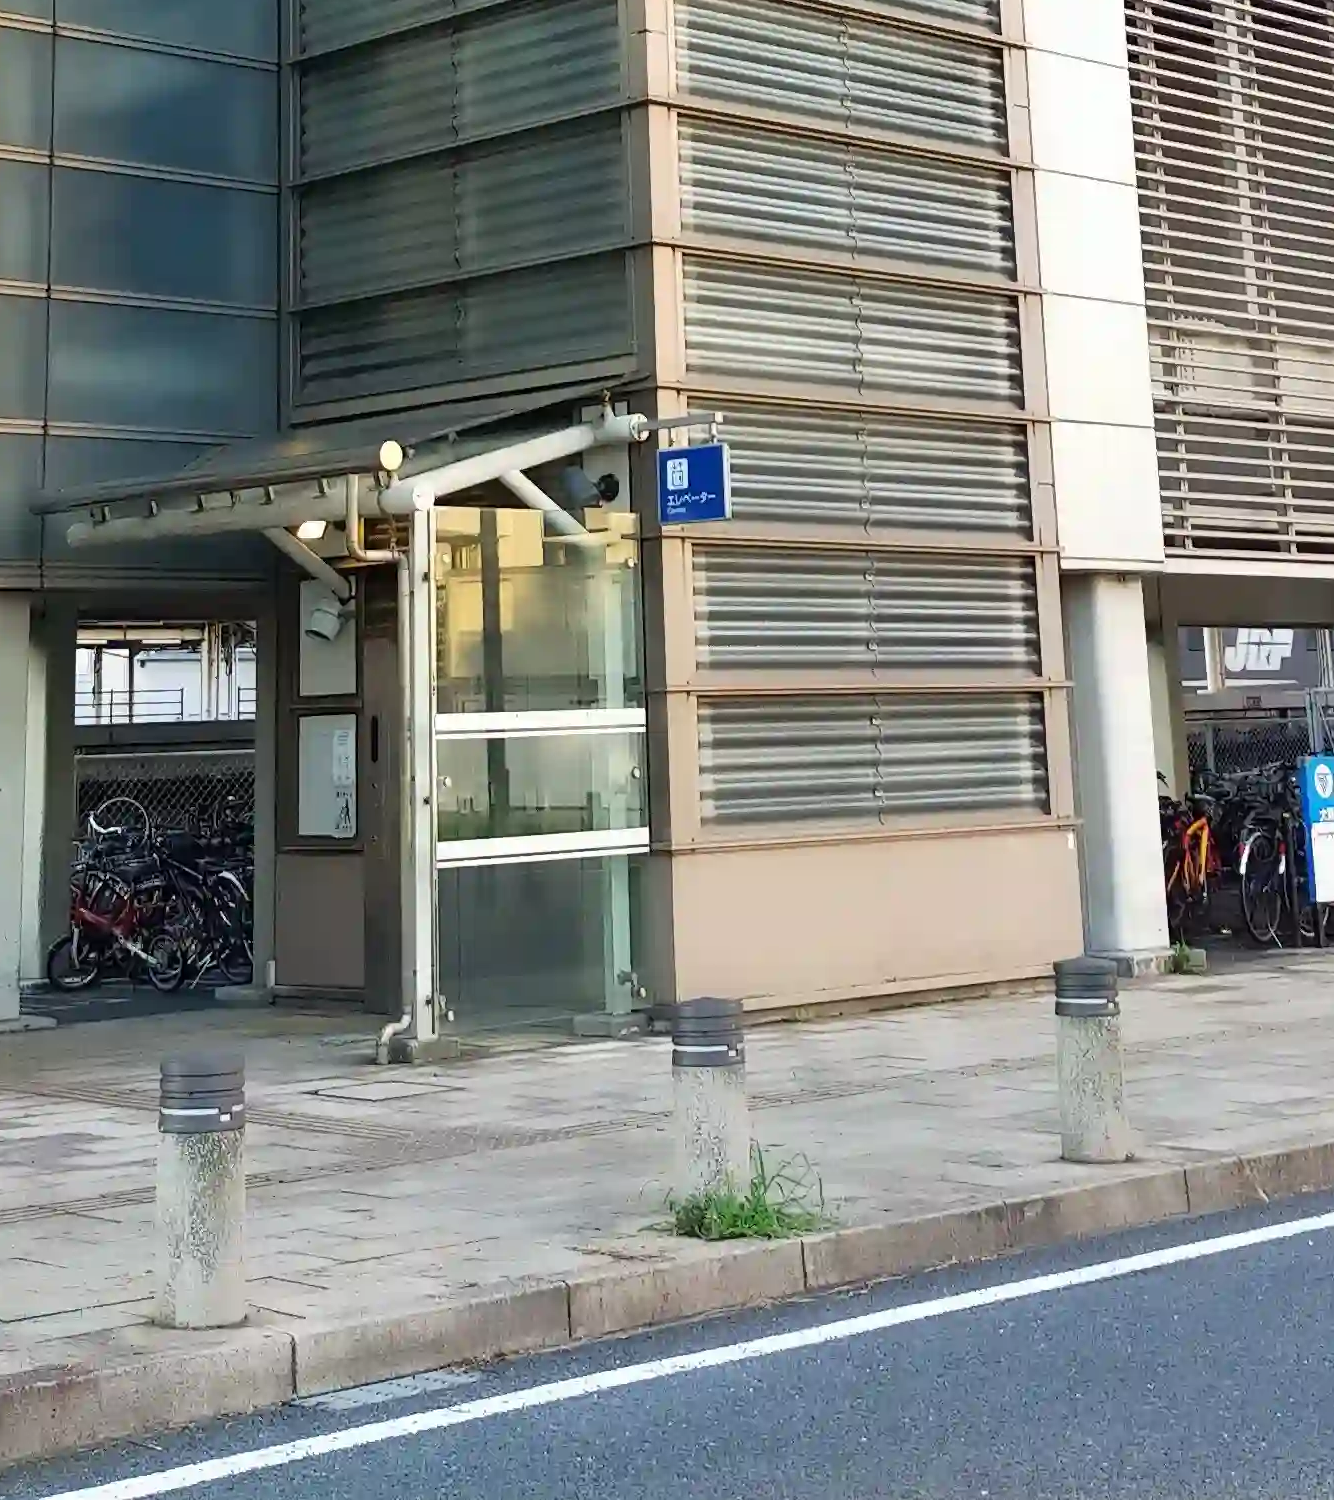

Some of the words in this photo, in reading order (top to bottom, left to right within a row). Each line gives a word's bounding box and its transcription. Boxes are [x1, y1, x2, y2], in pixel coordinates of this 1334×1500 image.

[667, 492, 716, 506] エレベーター
